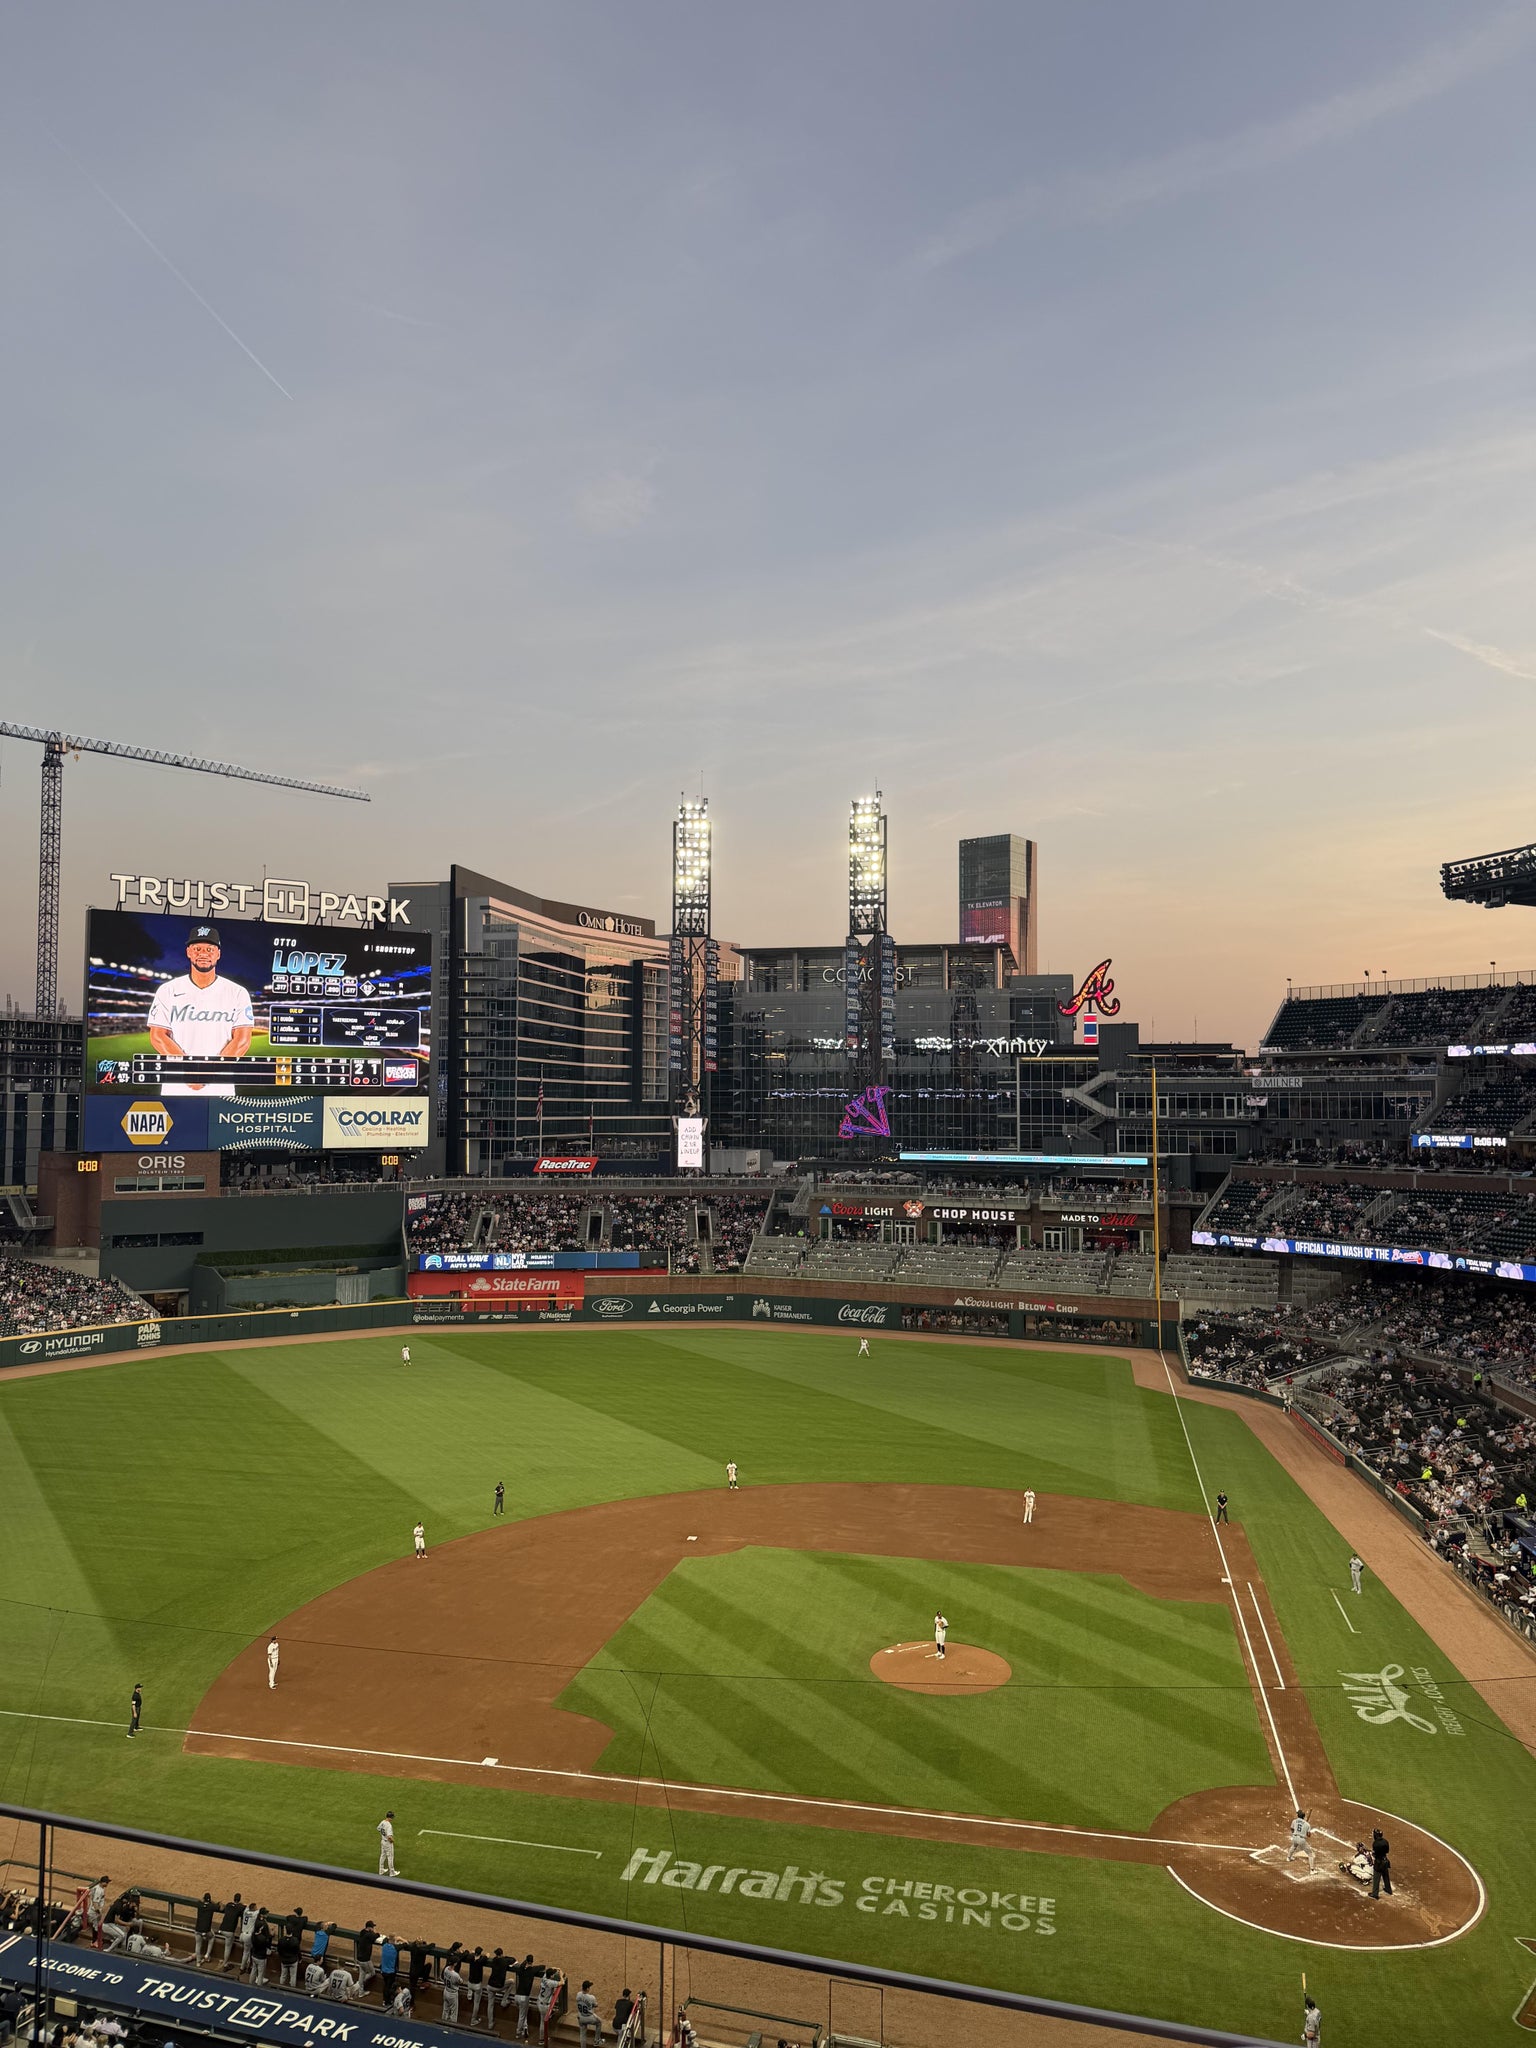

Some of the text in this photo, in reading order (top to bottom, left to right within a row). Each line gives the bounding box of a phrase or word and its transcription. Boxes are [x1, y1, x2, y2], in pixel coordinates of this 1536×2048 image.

[110, 873, 413, 925] TRUIST PARK
[976, 900, 1002, 909] ELEVATOR
[579, 912, 644, 936] OMNI HOTEL
[274, 938, 296, 948] OTTO
[272, 950, 347, 976] LOPEZ
[170, 1004, 236, 1022] Miami
[986, 1038, 1048, 1058] xfinity
[140, 1063, 144, 1071] 1
[155, 1063, 161, 1071] 3
[280, 1064, 286, 1072] 4
[354, 1064, 377, 1075] 2 1
[138, 1074, 145, 1082] 0
[156, 1074, 160, 1082] 1
[1263, 1079, 1301, 1087] MILNER
[130, 1114, 165, 1132] NAPA
[218, 1112, 314, 1124] NORTHSIDE
[338, 1110, 423, 1126] COOLRAY
[236, 1125, 296, 1133] HOSPITAL
[1493, 1138, 1506, 1147] PM
[78, 1160, 98, 1172] 0:08
[138, 1156, 185, 1169] ORIS
[382, 1155, 398, 1166] 0:08
[539, 1160, 591, 1170] RaceTrac
[832, 1202, 894, 1216] Coors LIGHT
[933, 1208, 1015, 1221] CHOP HOUSE
[1061, 1214, 1086, 1223] MADE
[1101, 1213, 1136, 1227] Chill
[1295, 1242, 1325, 1254] OFFICIAL
[1326, 1245, 1340, 1256] CAR
[1342, 1246, 1363, 1258] WASH
[1365, 1248, 1374, 1258] OF
[1374, 1248, 1389, 1260] THE
[495, 1257, 509, 1266] NL
[1466, 1259, 1478, 1267] TIDAL
[598, 1300, 626, 1312] Ford
[663, 1304, 723, 1314] Georgia Power
[964, 1297, 990, 1306] Coors
[1018, 1302, 1046, 1311] BELOW
[1056, 1304, 1078, 1313] CHOP
[837, 1304, 886, 1324] Coca-Cola
[138, 1323, 160, 1334] PAPA
[46, 1333, 104, 1350] HYUNDAI
[137, 1333, 160, 1342] JOHNS
[45, 1346, 91, 1357] HyundaiUSA.com
[1410, 1666, 1466, 1736] FREIGHT LOGISTICS
[1297, 1824, 1302, 1832] 6
[862, 1876, 1056, 1915] CHEROKEE
[244, 1916, 249, 1925] 9
[856, 1896, 1057, 1935] CASINOS
[306, 1973, 313, 1983] 21
[332, 1979, 342, 1989] 87
[540, 1987, 546, 1997] 2
[102, 1972, 124, 1984] TO
[136, 1978, 239, 2014] TRUIST
[275, 2010, 359, 2042] PARK
